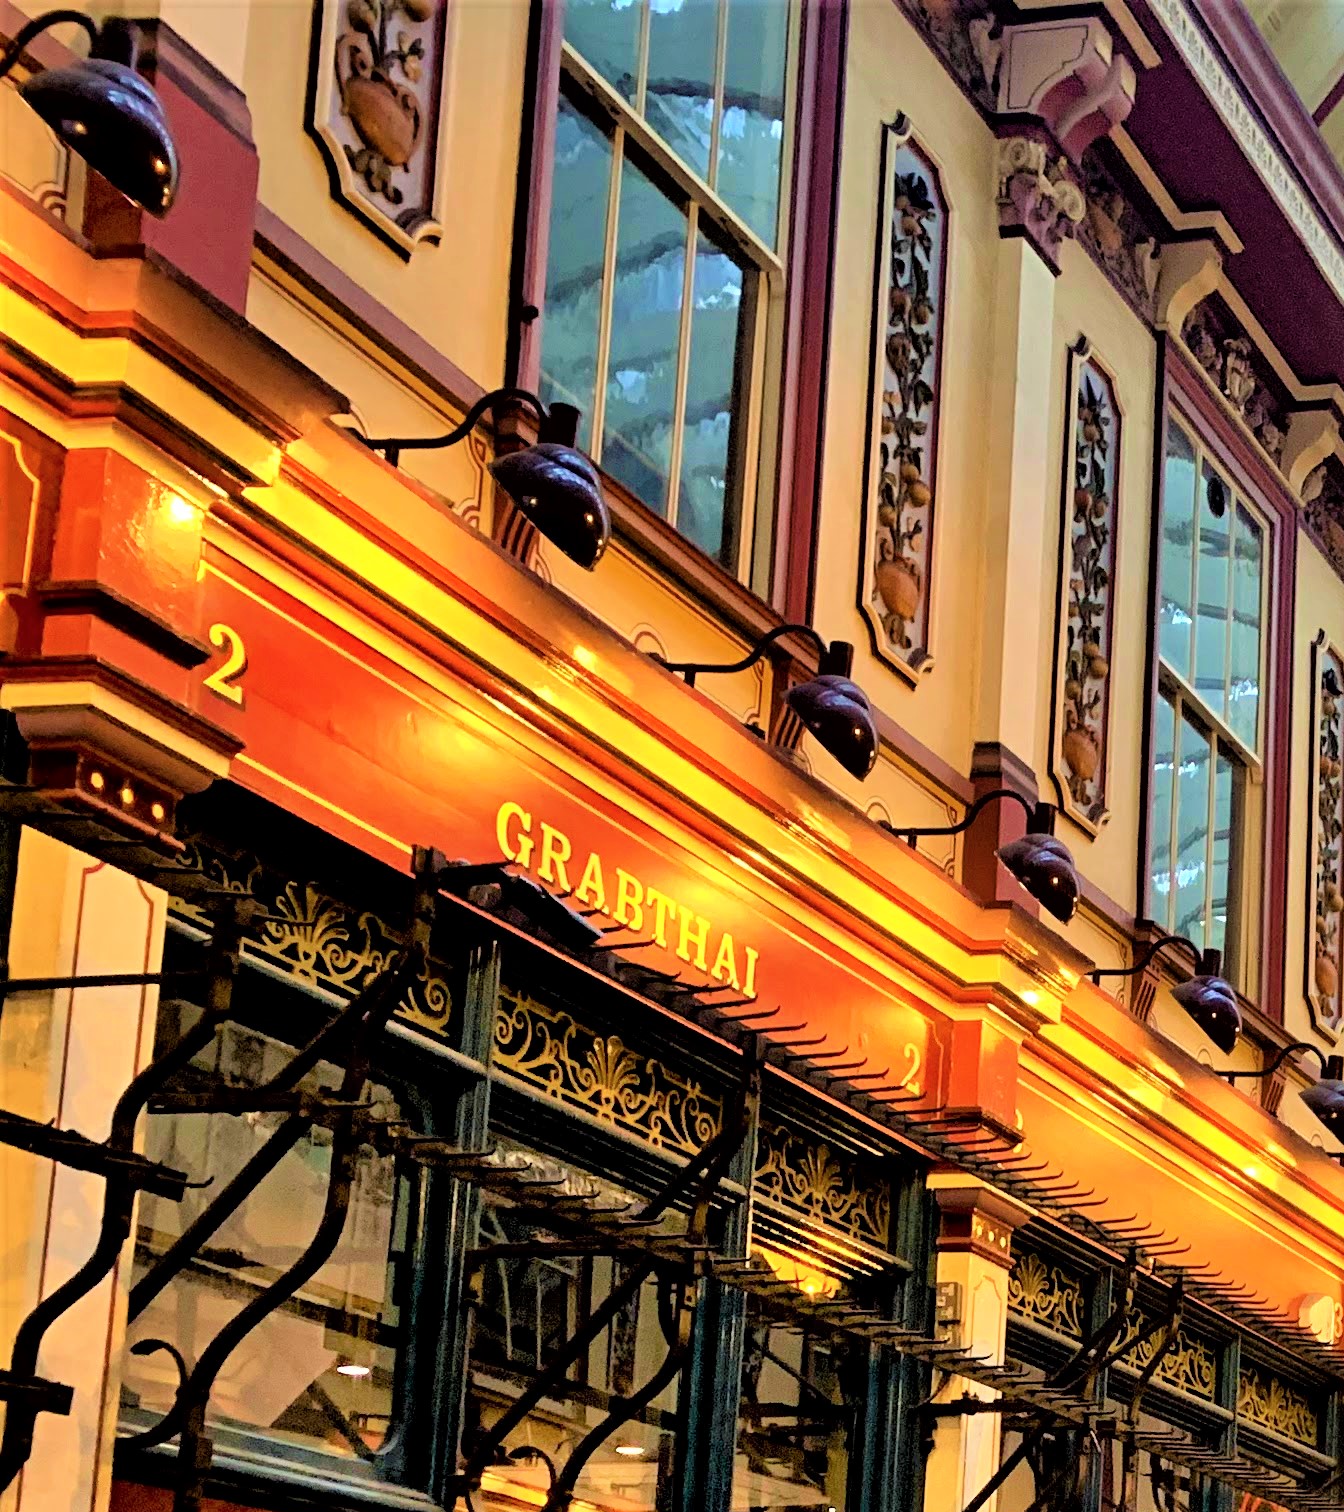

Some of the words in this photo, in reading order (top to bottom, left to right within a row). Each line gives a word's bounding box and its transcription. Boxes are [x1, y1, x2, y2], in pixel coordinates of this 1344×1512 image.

[202, 623, 245, 706] 2
[496, 801, 760, 999] GRABTHAI
[901, 1042, 921, 1097] 2
